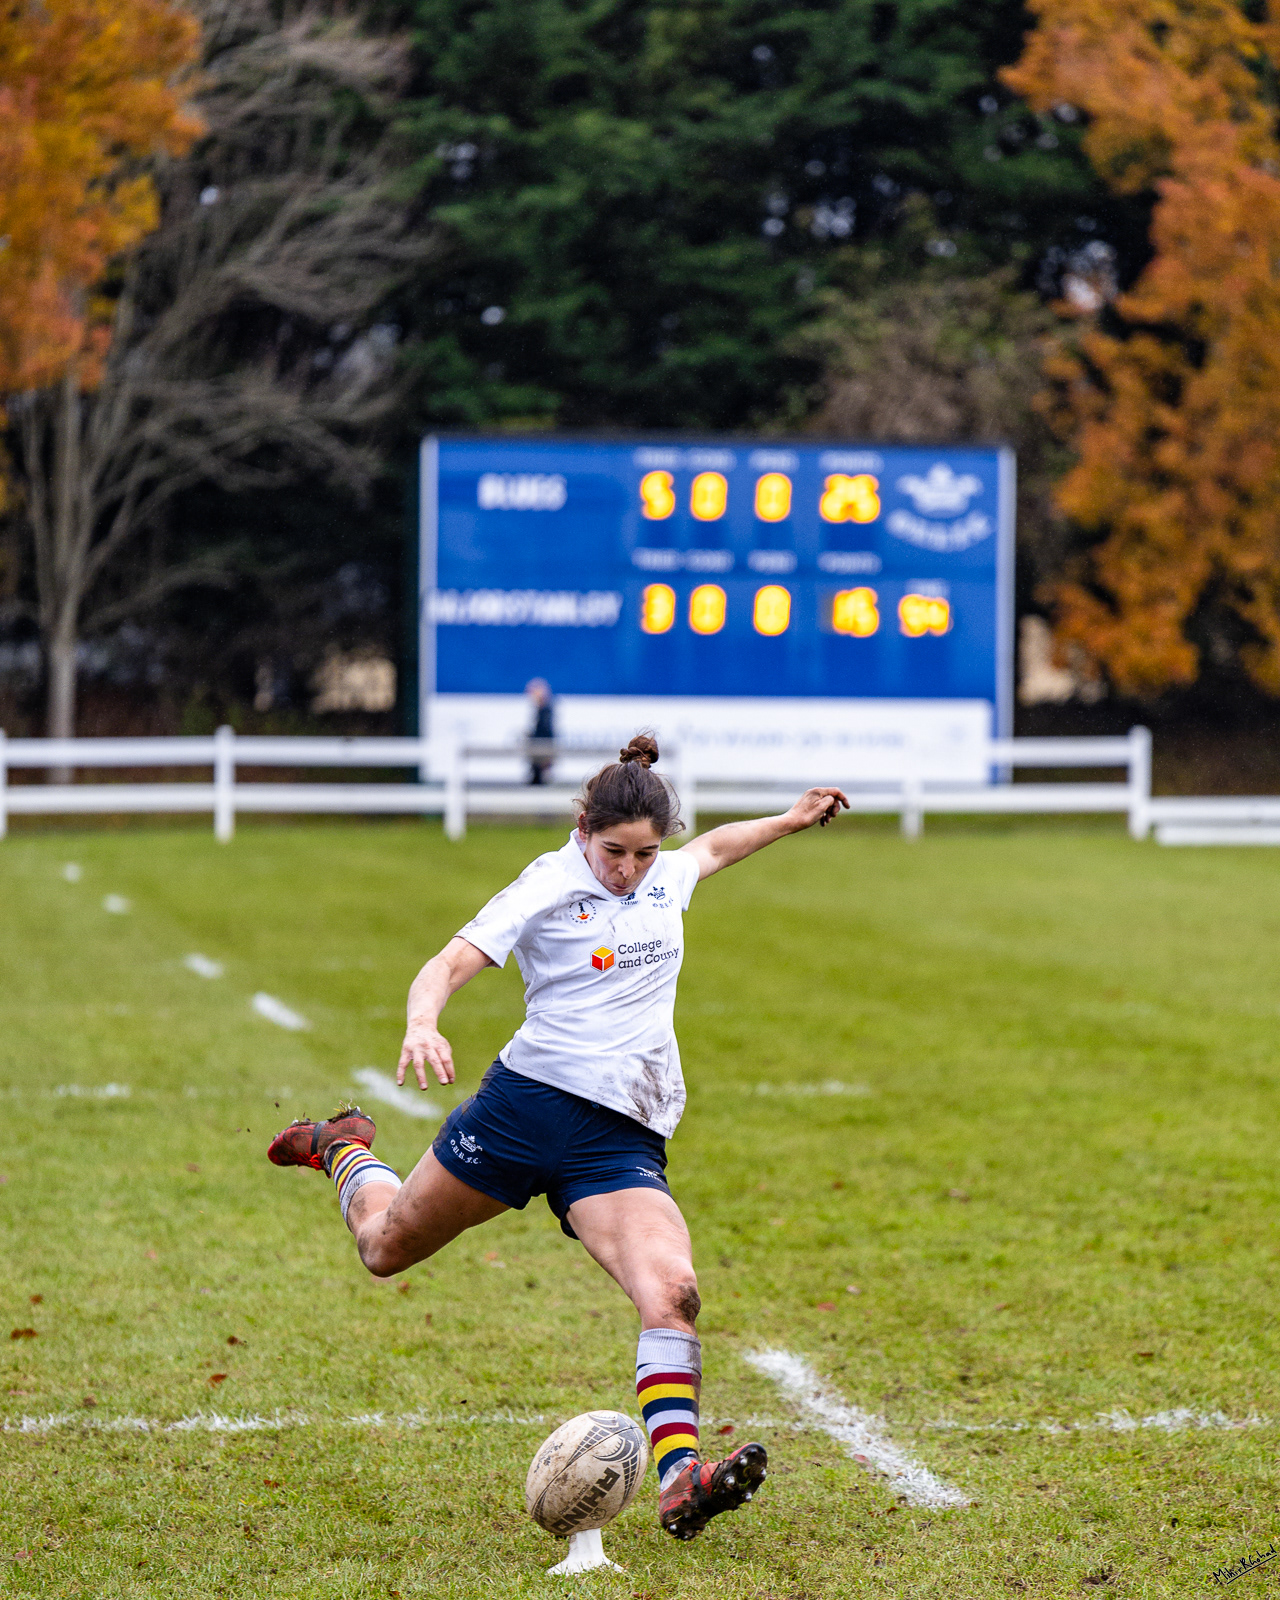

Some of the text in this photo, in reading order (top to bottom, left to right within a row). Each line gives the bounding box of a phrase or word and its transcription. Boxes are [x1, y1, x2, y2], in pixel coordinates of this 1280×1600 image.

[690, 471, 728, 521] 0
[754, 472, 792, 522] 0
[689, 584, 727, 635] 0
[753, 585, 792, 636] 0
[618, 939, 662, 954] College
[618, 948, 679, 969] and Couny
[551, 1467, 620, 1533] RHINO
